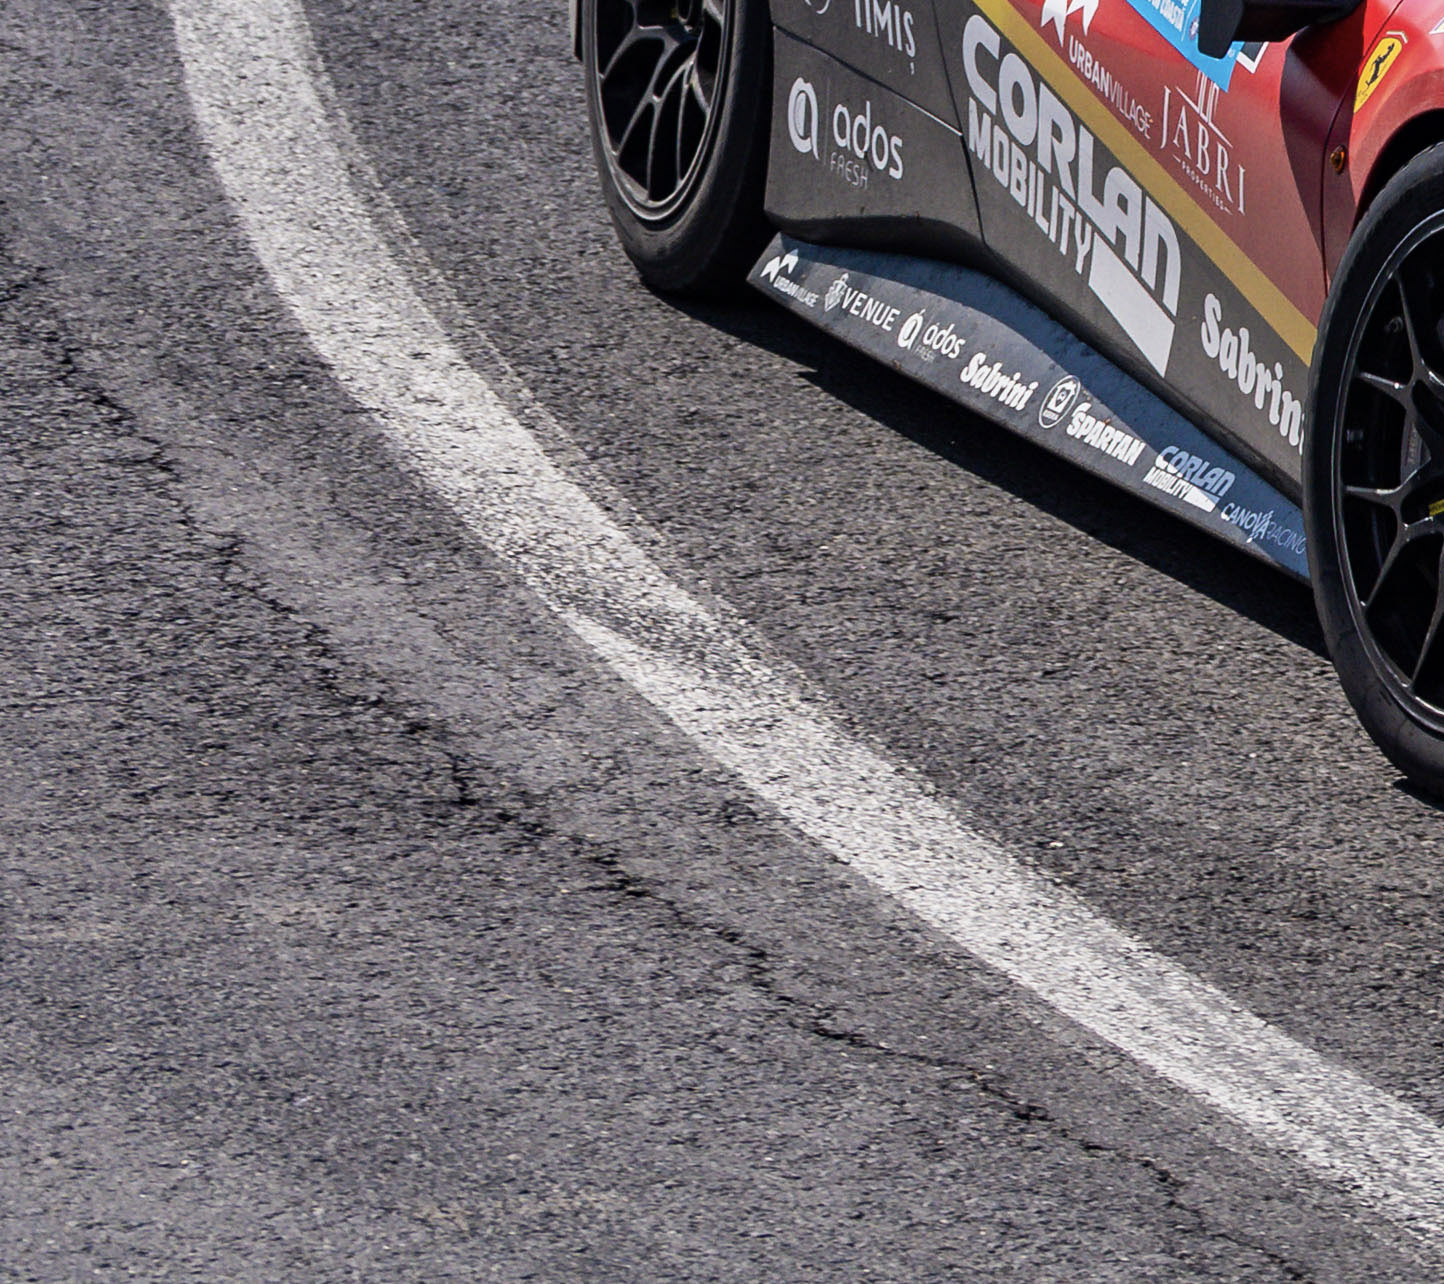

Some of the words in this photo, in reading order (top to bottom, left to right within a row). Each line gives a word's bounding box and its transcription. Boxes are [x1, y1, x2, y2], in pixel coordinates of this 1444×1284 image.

[1068, 35, 1153, 139] URBANVILLAGE
[832, 92, 905, 181] ados
[962, 14, 1182, 317] CORLAN
[1160, 85, 1247, 216] JABRI
[967, 98, 1094, 275] MOBILITY
[840, 286, 901, 332] VENUE
[959, 351, 1040, 412] Sabrini
[1065, 402, 1147, 467] SPARTAN
[1142, 465, 1193, 501] MOBILITY
[1154, 445, 1237, 498] CORLAN
[1220, 501, 1269, 540] CANOVA
